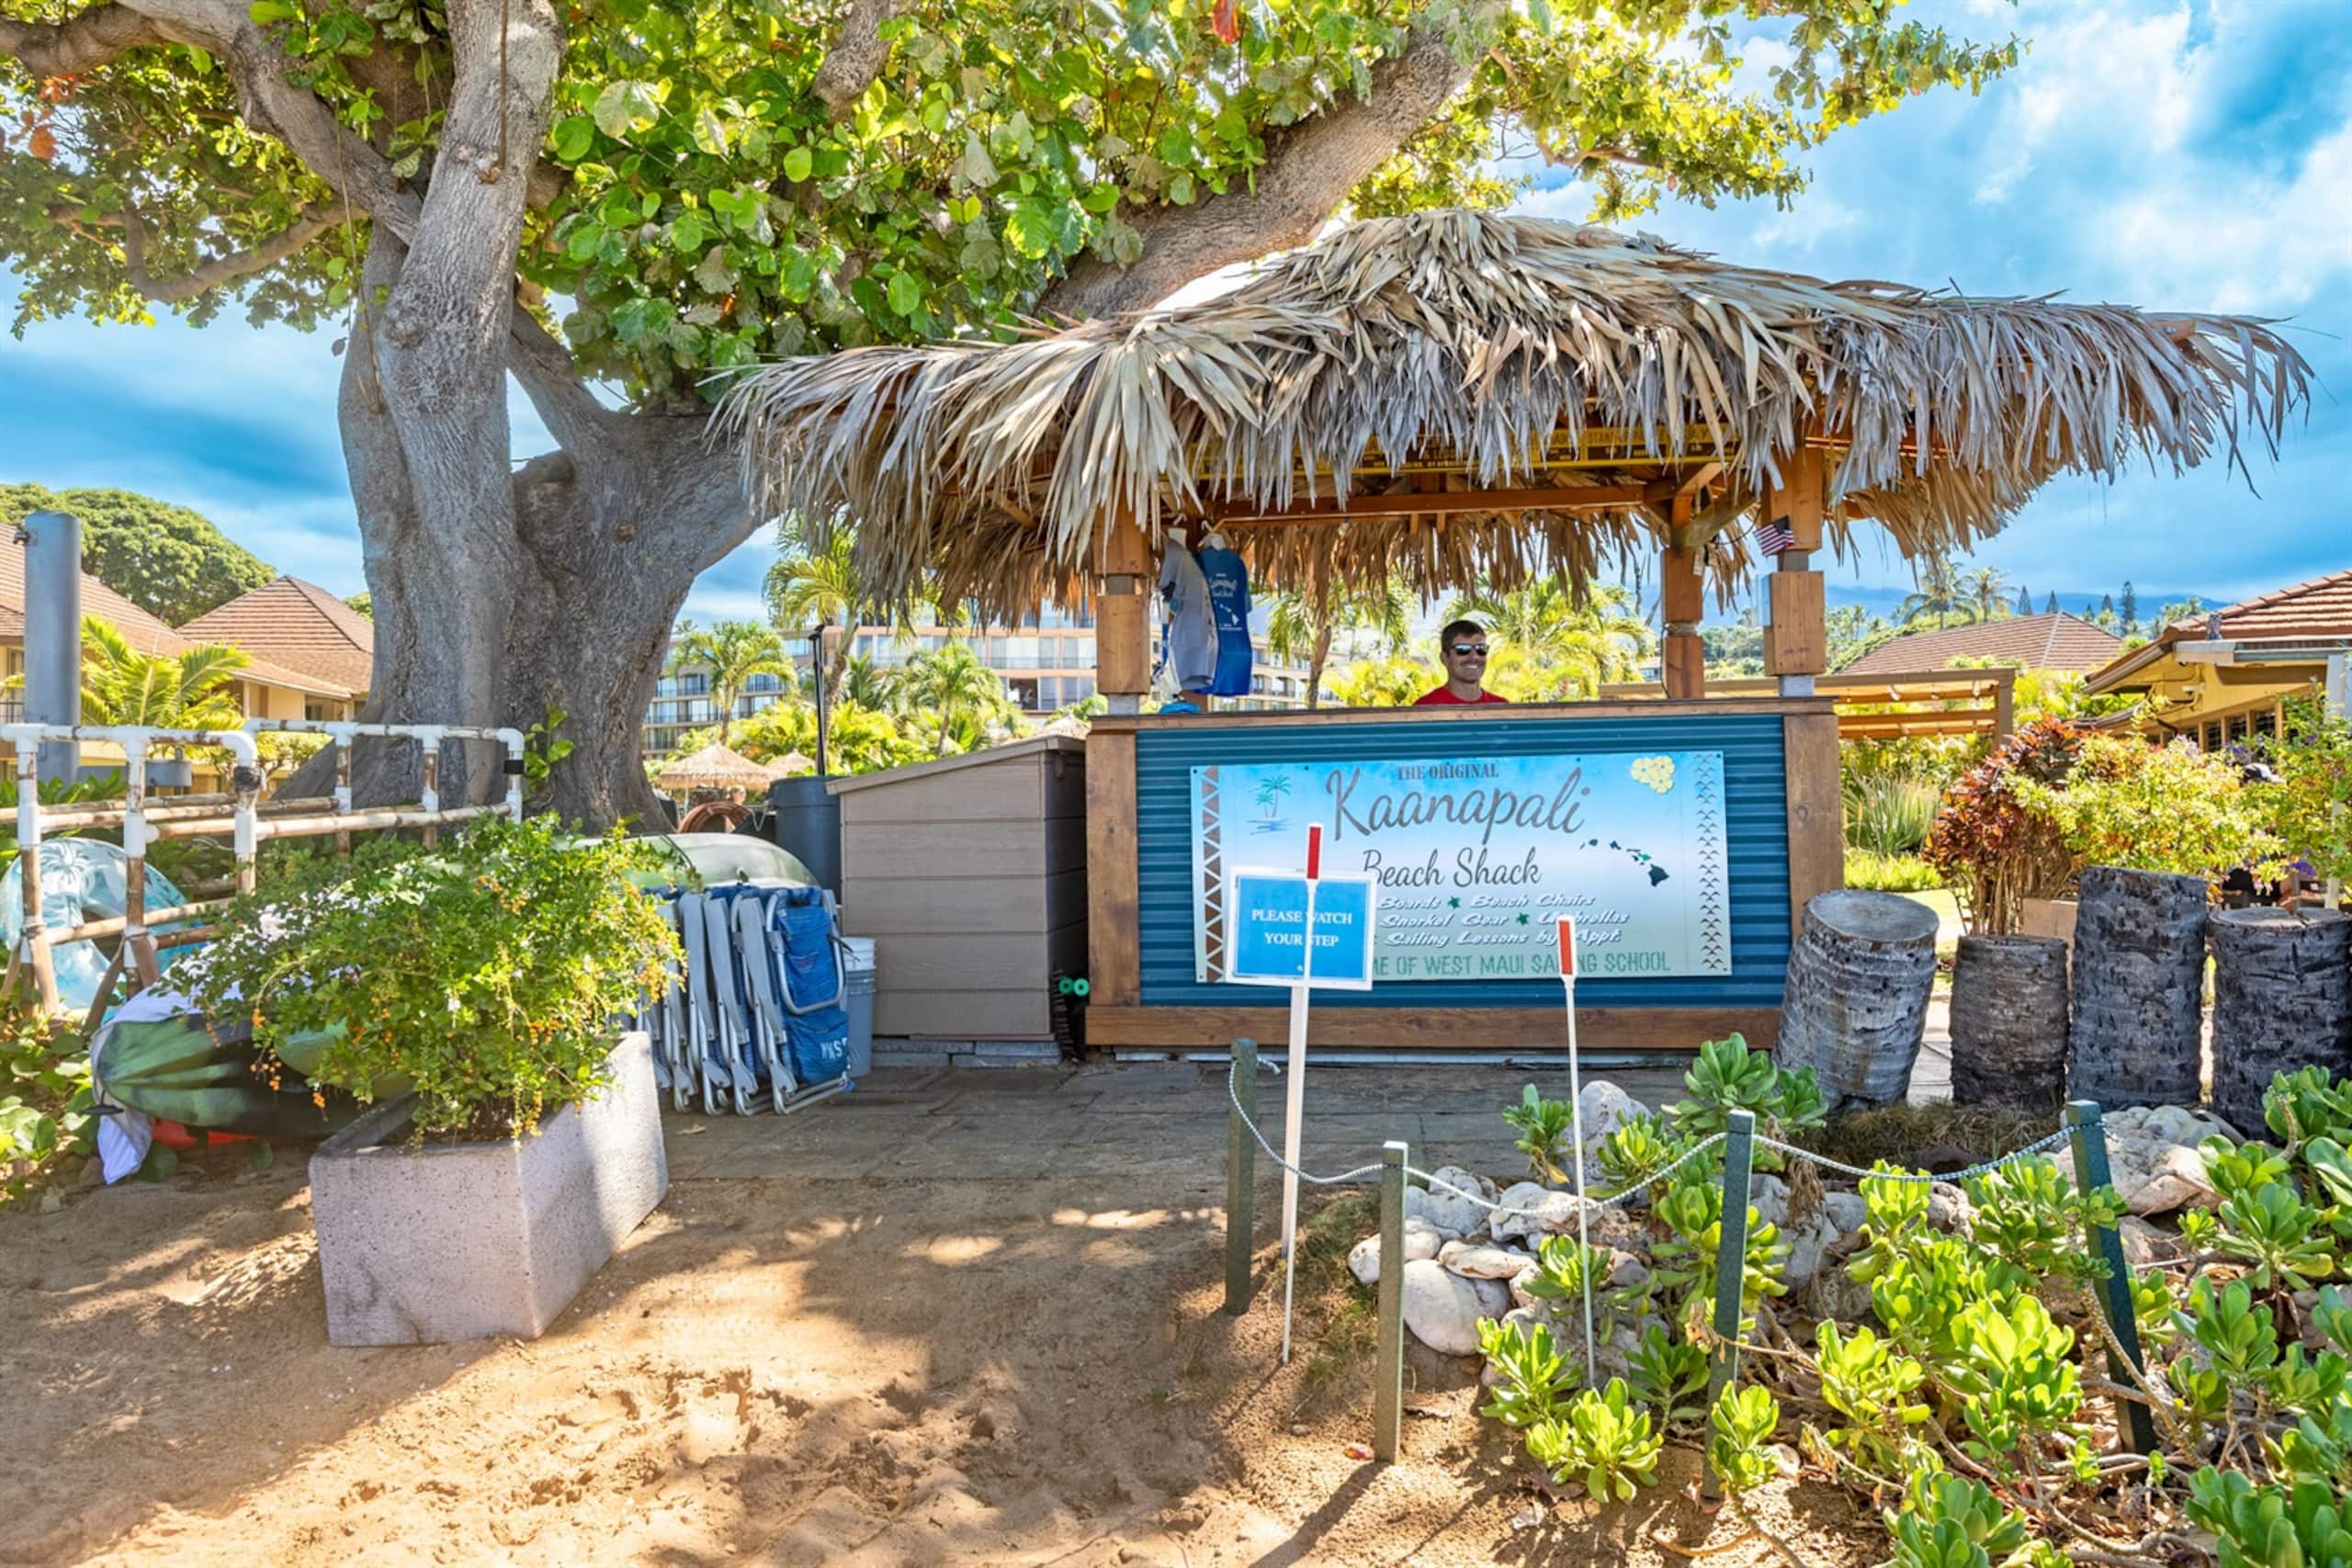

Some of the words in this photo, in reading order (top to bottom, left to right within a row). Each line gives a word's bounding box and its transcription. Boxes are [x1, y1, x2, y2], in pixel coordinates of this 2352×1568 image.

[1397, 764, 1426, 780] THE
[1429, 762, 1499, 780] ORIGINAL
[1326, 766, 1590, 845] Kaanapali
[1363, 849, 1445, 887] Beach
[1453, 846, 1542, 887] Shack
[1377, 896, 1442, 910] Boards
[1470, 894, 1529, 908] Beach
[1536, 893, 1595, 908] Chairs
[1251, 908, 1302, 923] PLEASE
[1380, 913, 1454, 929] Snorkel
[1462, 912, 1509, 927] Gear
[1536, 909, 1630, 925] Ubrellas
[1264, 932, 1302, 945] YOUR
[1307, 934, 1339, 947] TEP
[1384, 931, 1449, 948] Sailing
[1456, 931, 1529, 945] Lessons
[1536, 929, 1558, 946] by
[1396, 956, 1417, 976] OF
[1425, 955, 1472, 976] WEST
[1480, 954, 1524, 976] MAUI
[1531, 953, 1598, 974] SANG
[1604, 951, 1671, 972] SCHOOL
